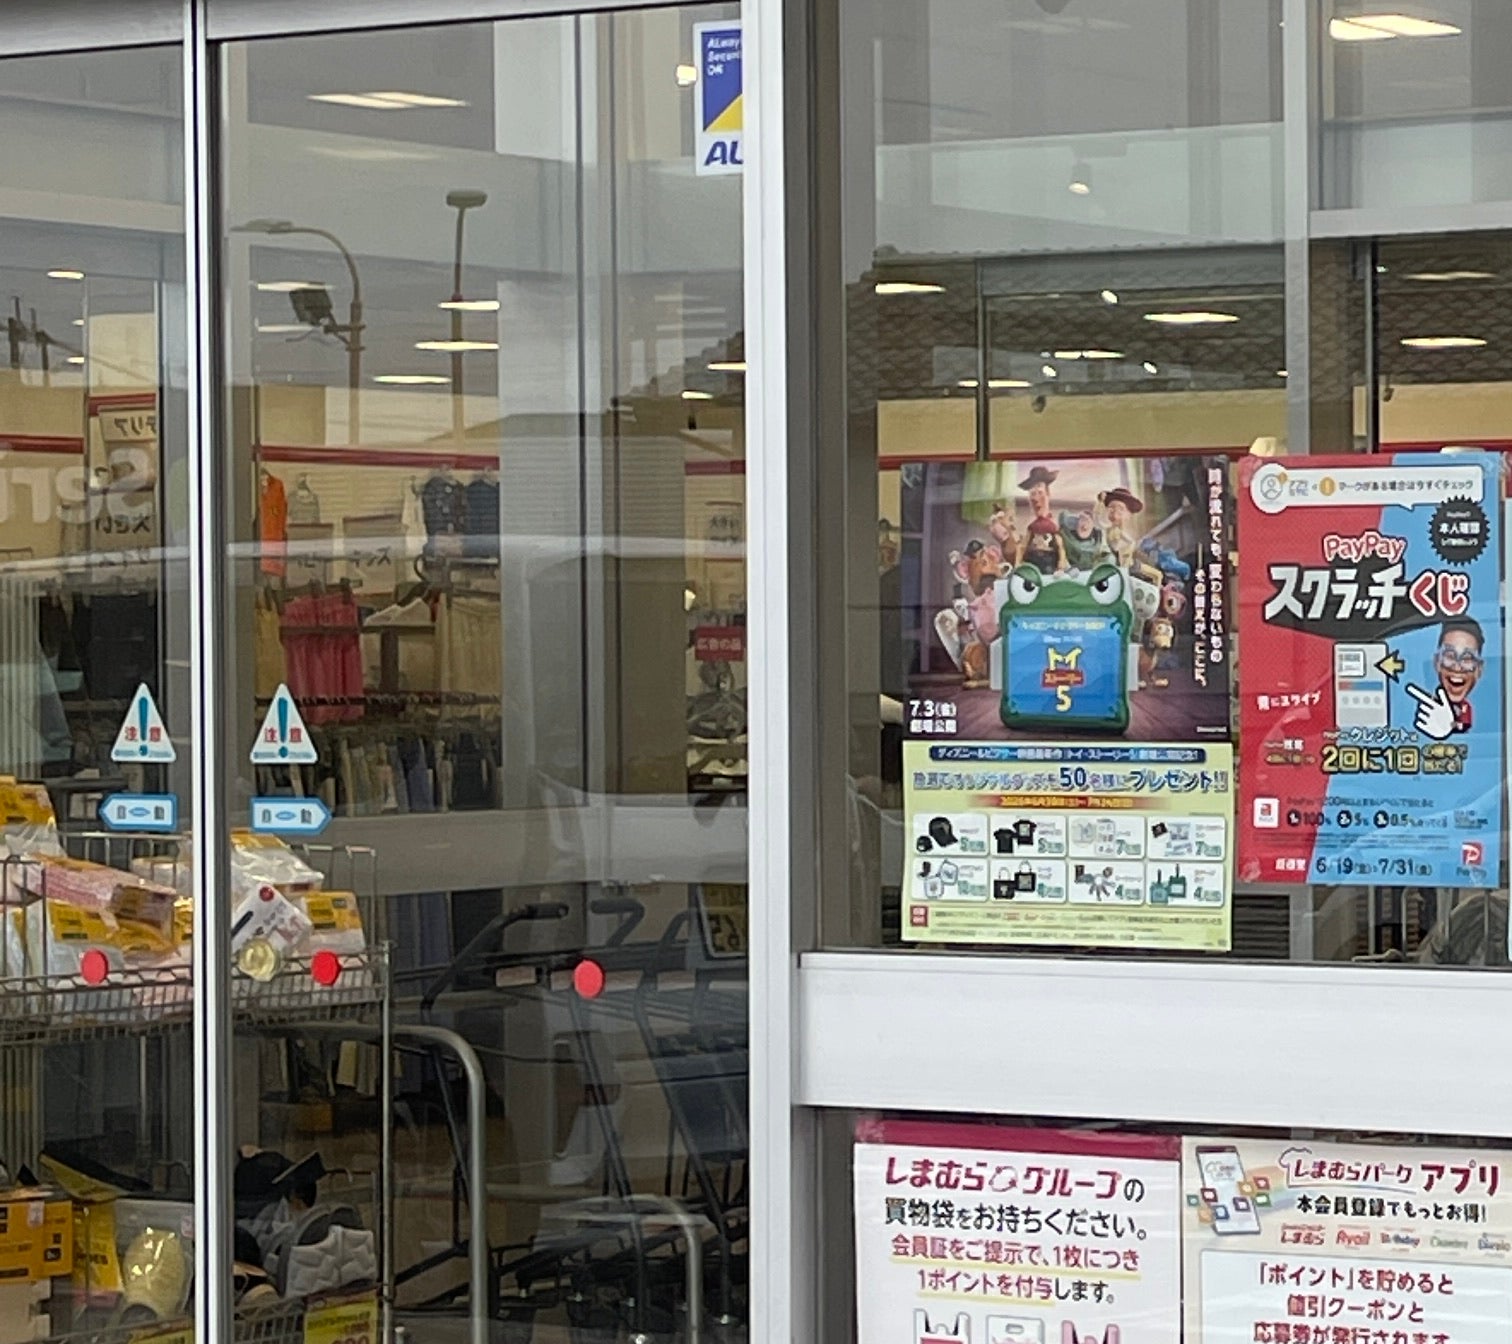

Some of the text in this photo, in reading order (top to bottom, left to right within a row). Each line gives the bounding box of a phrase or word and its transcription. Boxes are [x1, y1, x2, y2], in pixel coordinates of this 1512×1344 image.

[1326, 533, 1406, 560] PayPay
[1265, 564, 1469, 621] スクラッチくじ
[1056, 686, 1071, 712] 5
[885, 1156, 1145, 1203] しまむらグループの
[1293, 1158, 1501, 1196] しまむらパーク アプリ
[884, 1196, 1147, 1241] 買物袋をお持ちください。
[1296, 1194, 1487, 1223] 本会員登録でもっとお得!
[891, 1233, 1141, 1272] 会員証をご提示で、1枚につき
[917, 1268, 1115, 1305] 1ポイントを付与します。
[1260, 1262, 1454, 1295] 「ポイント」を貯めると
[1287, 1293, 1425, 1323] 値引クーポンと
